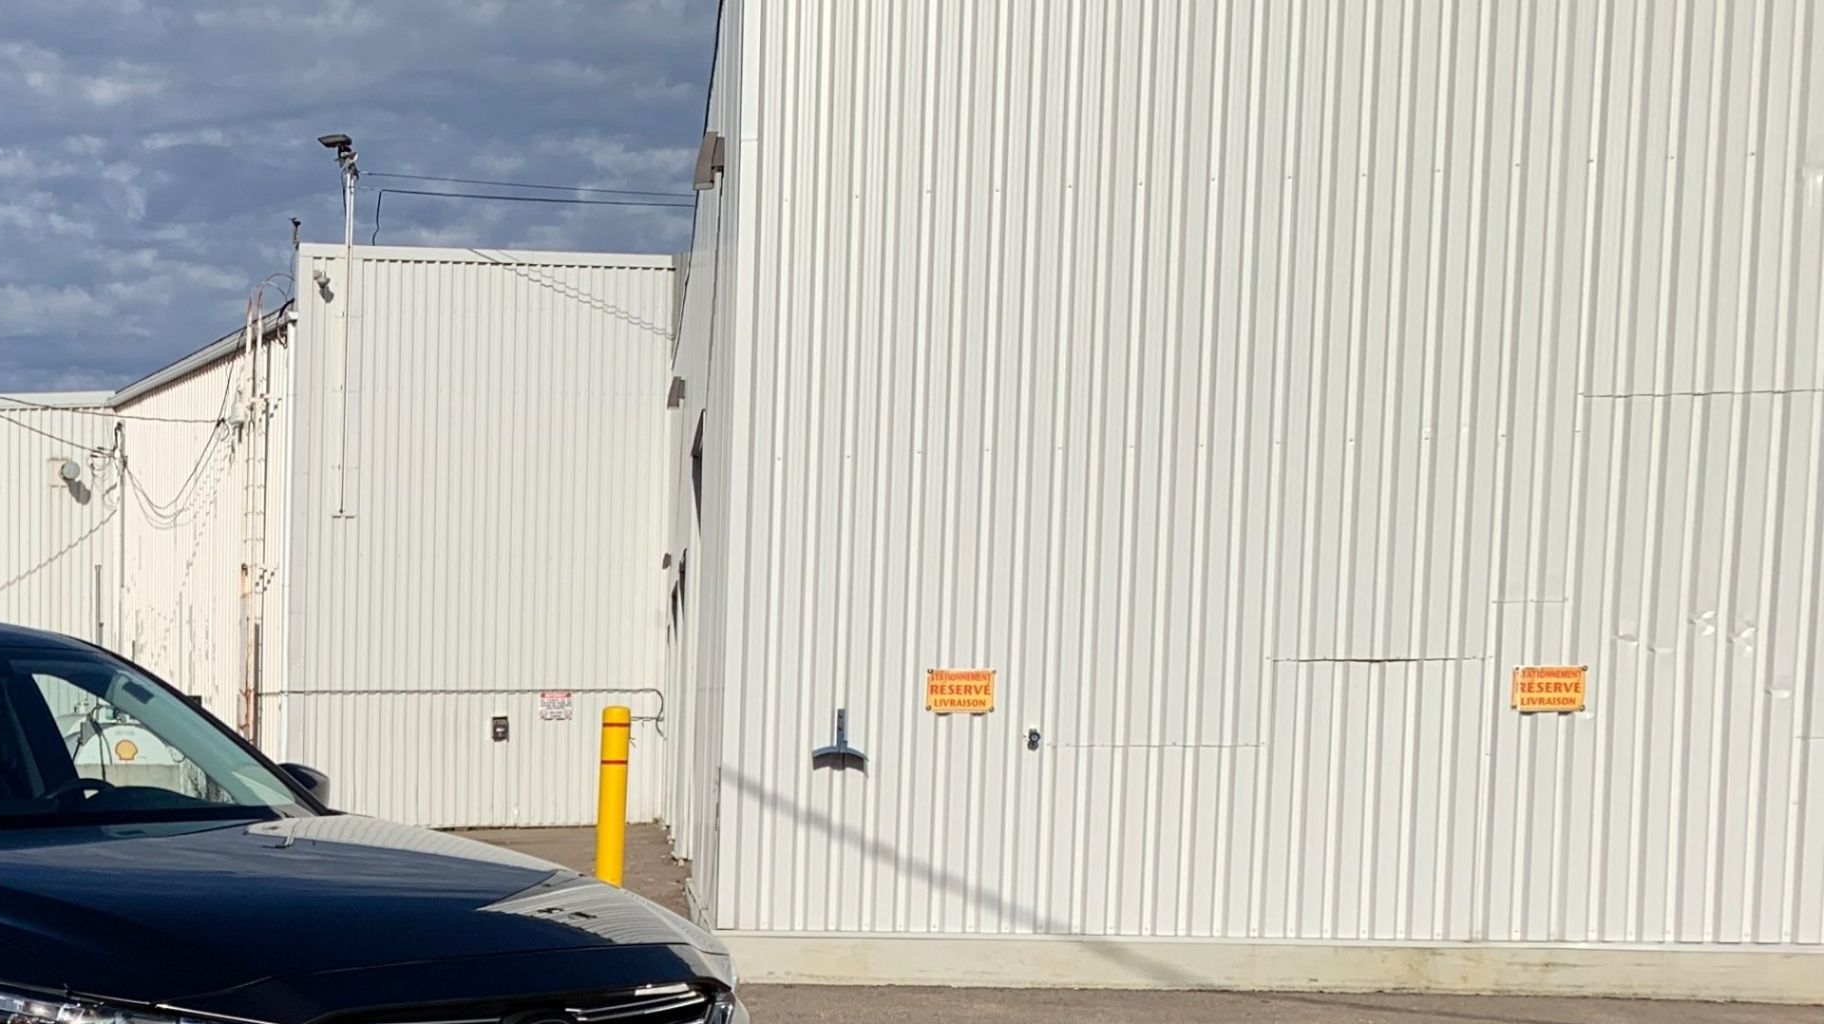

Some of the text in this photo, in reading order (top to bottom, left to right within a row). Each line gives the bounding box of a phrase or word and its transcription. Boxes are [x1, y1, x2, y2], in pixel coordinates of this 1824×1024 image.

[1521, 669, 1582, 679] TATIONNEMENT
[933, 698, 986, 707] LIVRAISON
[1520, 697, 1577, 706] LIVRAISON
